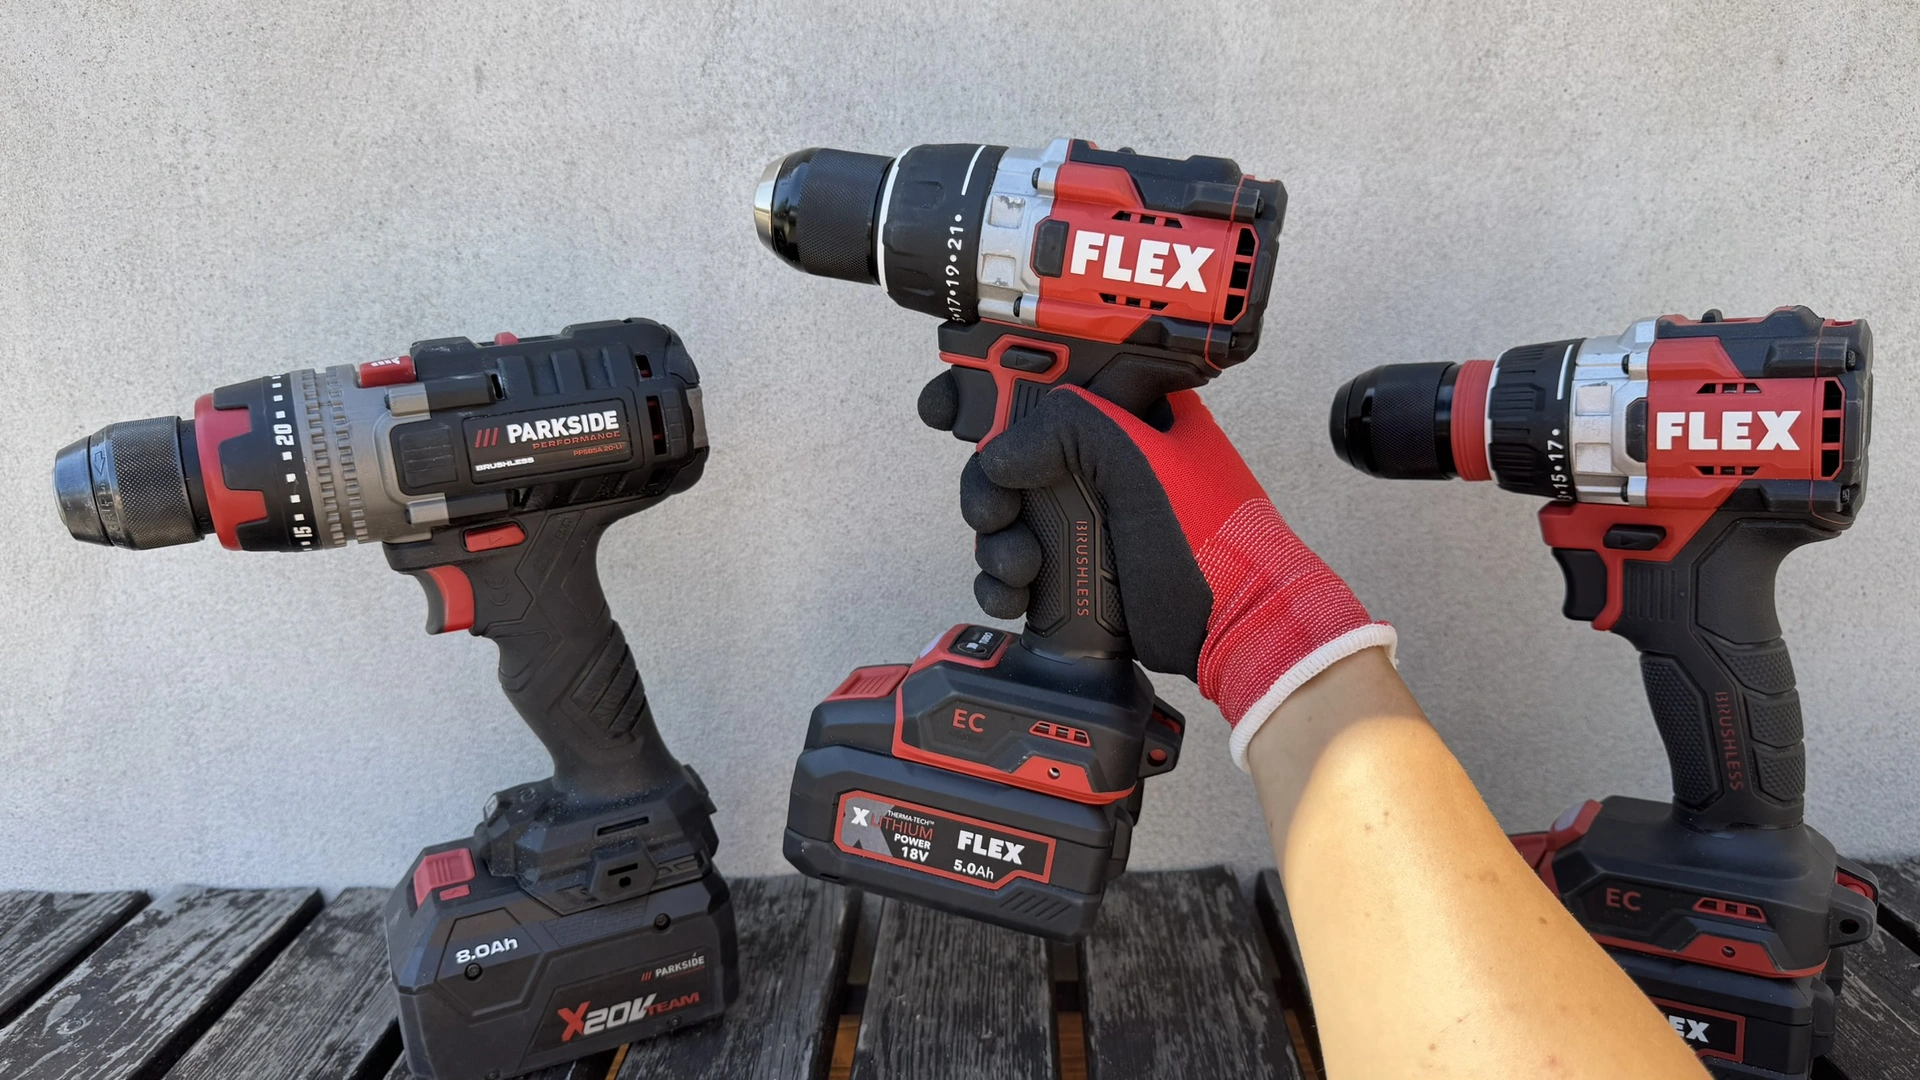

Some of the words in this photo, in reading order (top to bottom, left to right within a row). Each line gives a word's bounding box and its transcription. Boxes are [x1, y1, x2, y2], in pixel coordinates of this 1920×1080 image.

[947, 226, 964, 251] 21
[1070, 231, 1214, 293] FLEX
[945, 264, 960, 287] 19
[273, 423, 295, 446] 20
[506, 410, 619, 444] PARKSIDE
[1655, 410, 1801, 451] FLEX
[532, 431, 621, 450] PERFORMANCE
[1547, 440, 1564, 461] 17
[475, 456, 535, 472] BRUSHLESS
[1551, 474, 1569, 489] 15
[293, 526, 313, 538] 15
[1076, 521, 1089, 616] BRUSHLESS
[952, 708, 986, 733] EC
[1715, 691, 1744, 790] BRUSHLESS
[870, 813, 934, 840] LITHIUM
[894, 832, 931, 850] POWER
[957, 829, 1026, 866] FLEX
[901, 846, 930, 863] 18V
[953, 858, 995, 881] 5.0Ah
[1606, 887, 1642, 912] EC
[455, 937, 518, 964] 8.0Ah
[655, 954, 706, 978] PARKSIDE
[645, 991, 700, 1017] TEAM
[1667, 1014, 1710, 1044] EX
